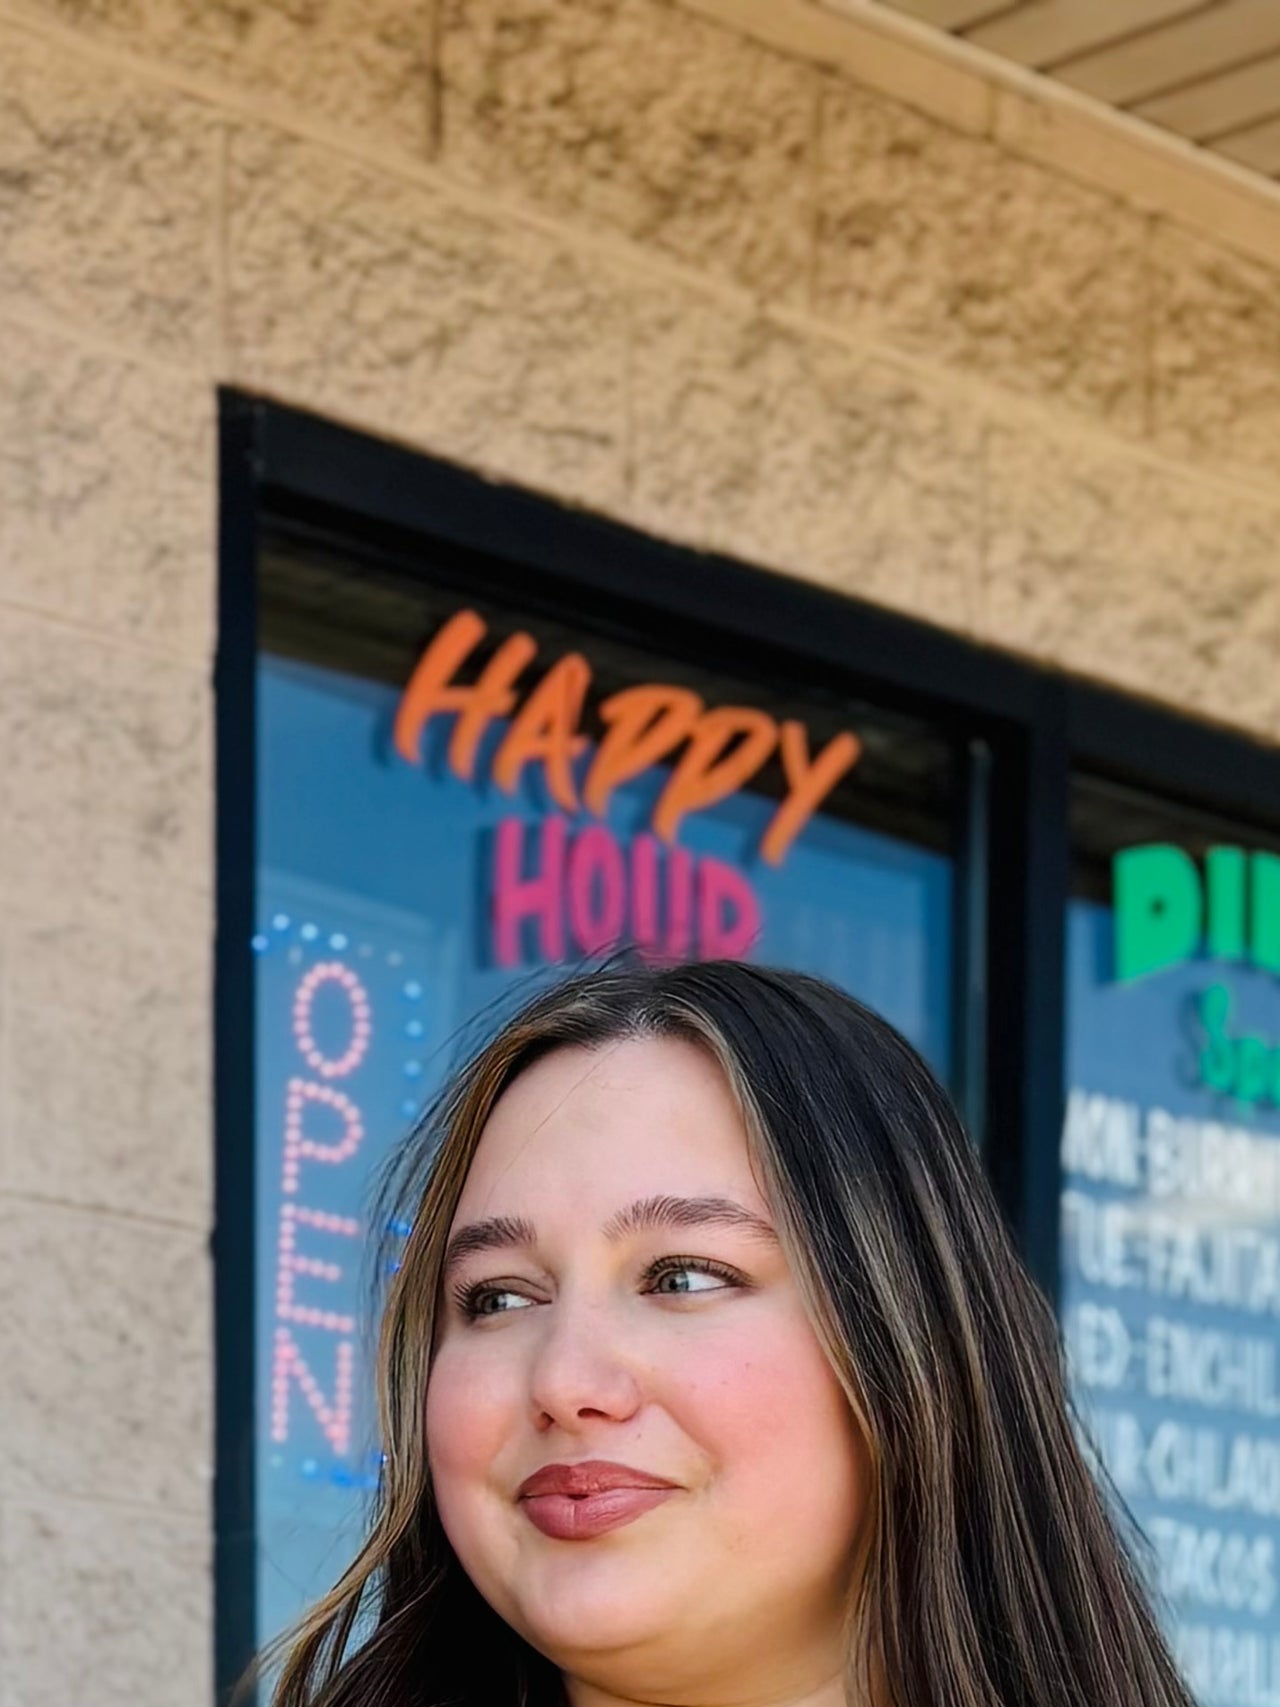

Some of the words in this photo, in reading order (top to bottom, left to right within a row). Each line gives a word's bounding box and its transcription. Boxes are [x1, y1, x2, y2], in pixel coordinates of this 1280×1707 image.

[390, 609, 861, 868] HAPPY
[492, 816, 761, 968] HOUR
[270, 962, 372, 1456] OPEN
